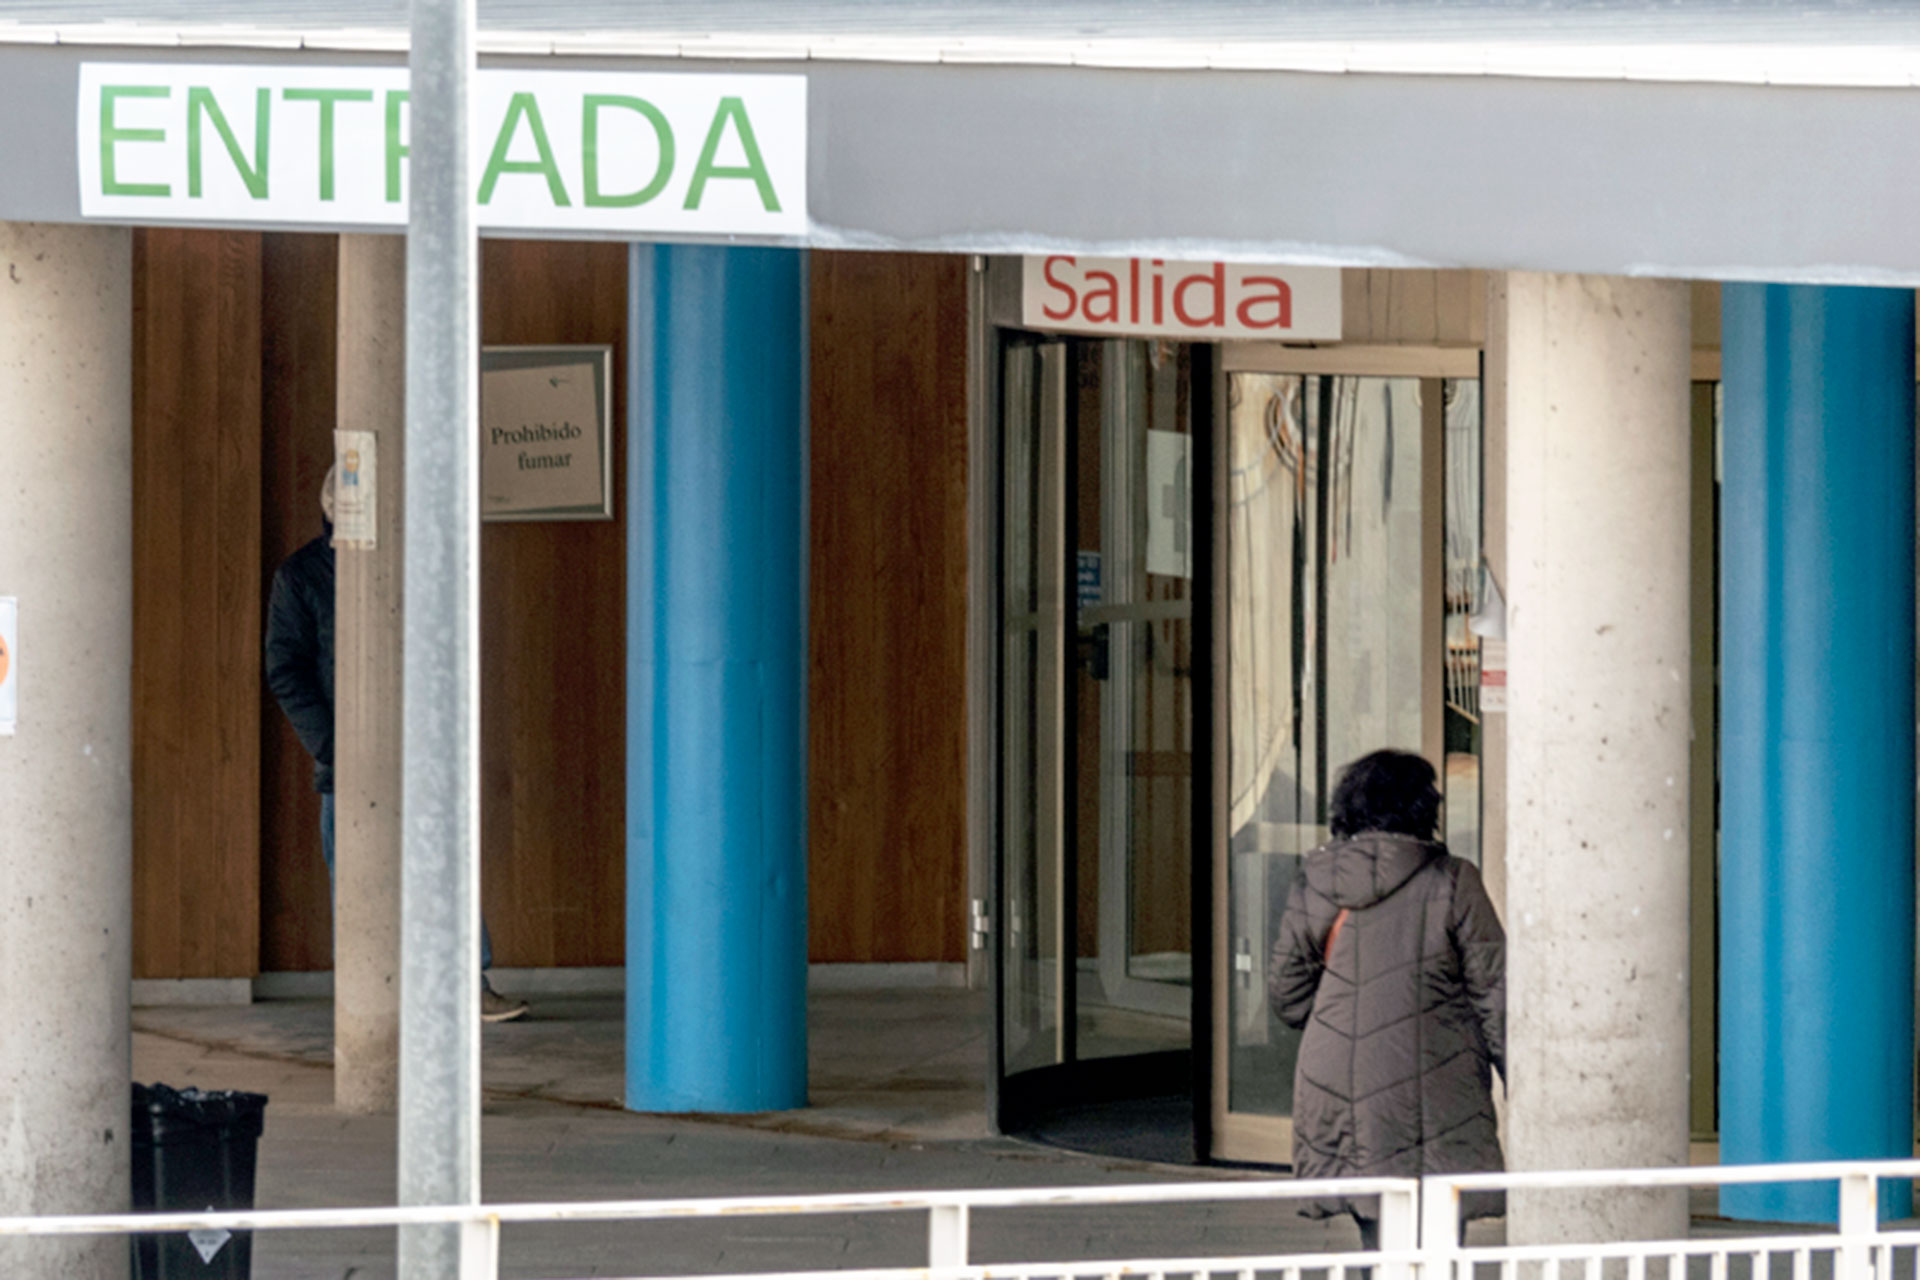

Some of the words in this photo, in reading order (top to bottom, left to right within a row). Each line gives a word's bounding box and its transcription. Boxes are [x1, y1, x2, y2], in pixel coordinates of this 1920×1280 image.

[1042, 255, 1292, 329] Salida
[491, 422, 582, 445] Prohibido
[518, 451, 572, 471] fumar
